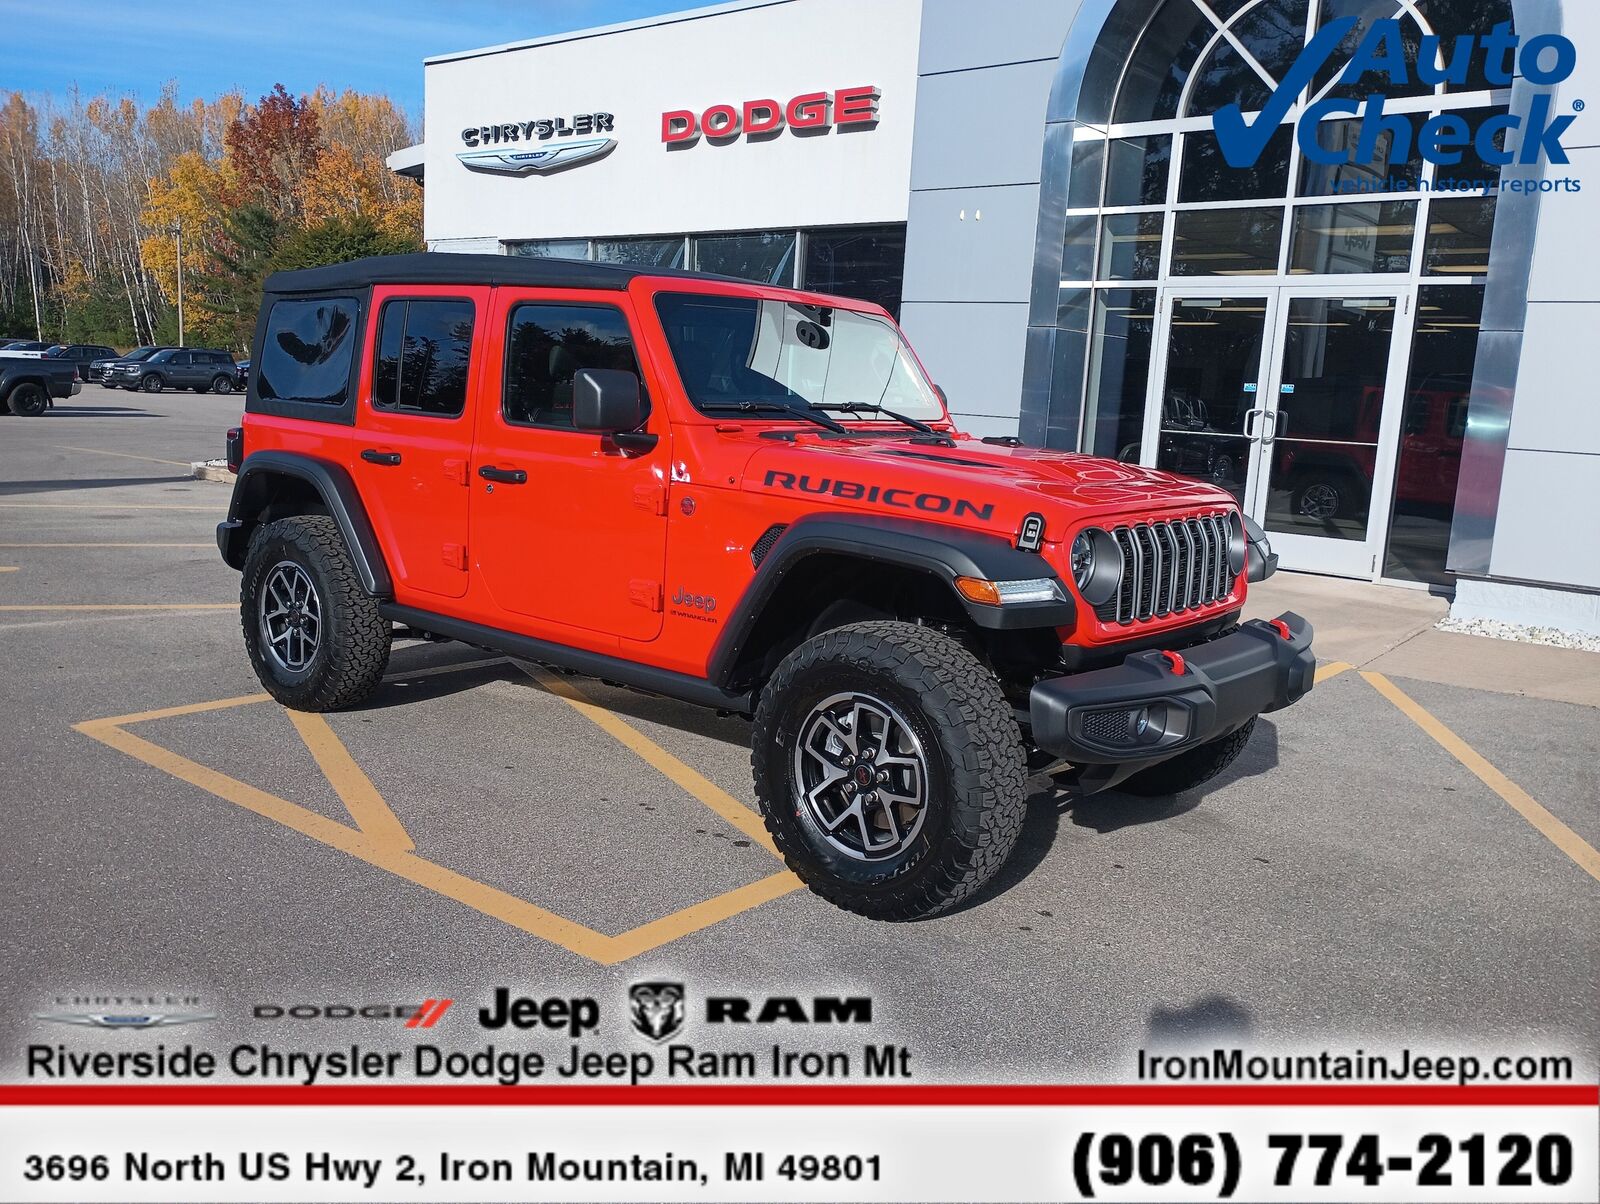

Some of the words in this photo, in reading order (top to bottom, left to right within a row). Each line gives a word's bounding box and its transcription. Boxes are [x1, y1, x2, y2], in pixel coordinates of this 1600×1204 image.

[461, 111, 613, 147] CHRYSLER
[662, 86, 880, 146] DODGE
[763, 469, 996, 521] RUBICON
[671, 585, 717, 614] Jeep
[676, 610, 718, 624] WRANGLER
